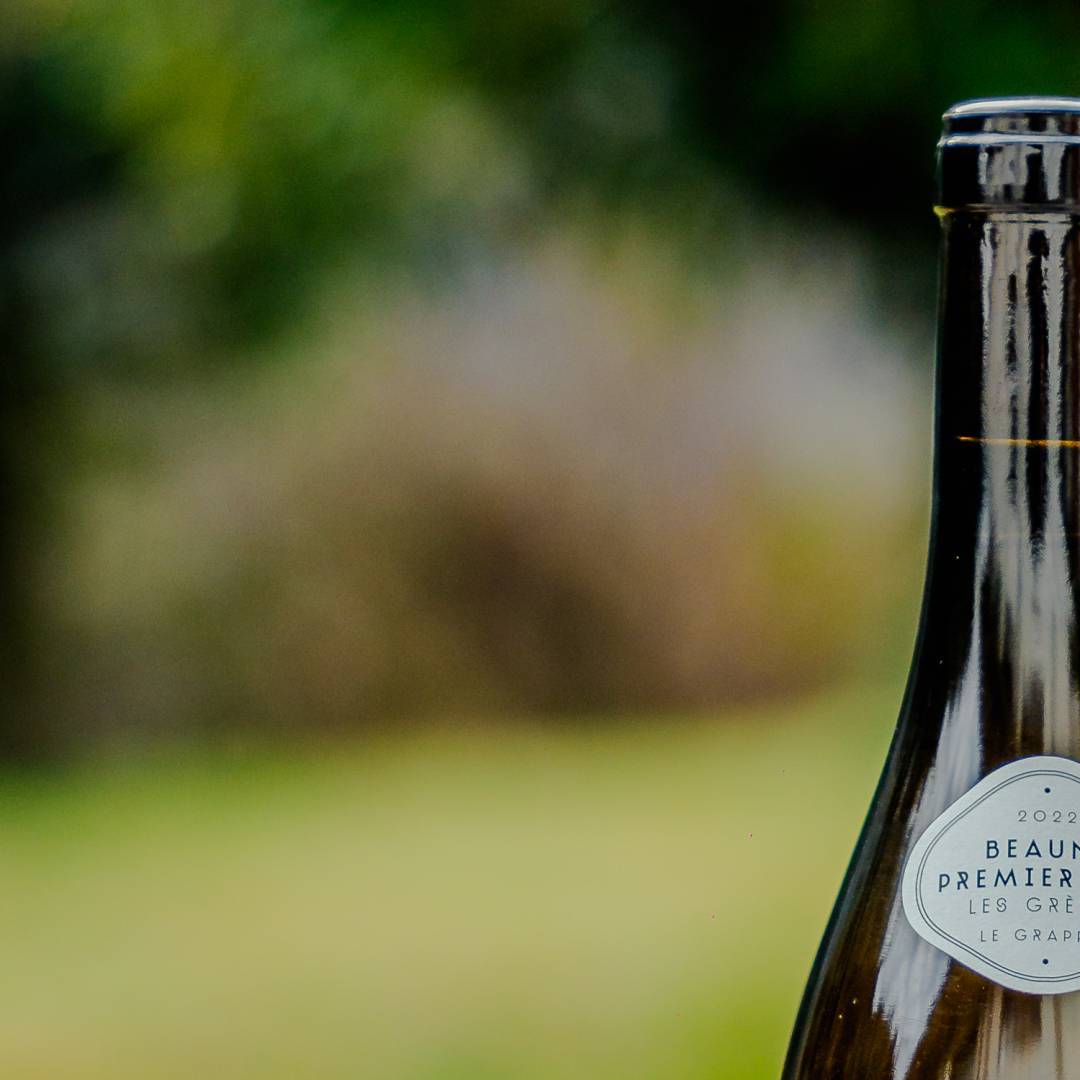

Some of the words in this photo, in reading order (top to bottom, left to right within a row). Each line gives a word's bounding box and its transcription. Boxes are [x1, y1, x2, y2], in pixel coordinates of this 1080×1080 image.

[1017, 809, 1078, 824] 2022
[938, 867, 1073, 893] PREMIER
[969, 897, 1008, 915] LES
[980, 929, 999, 943] LE
